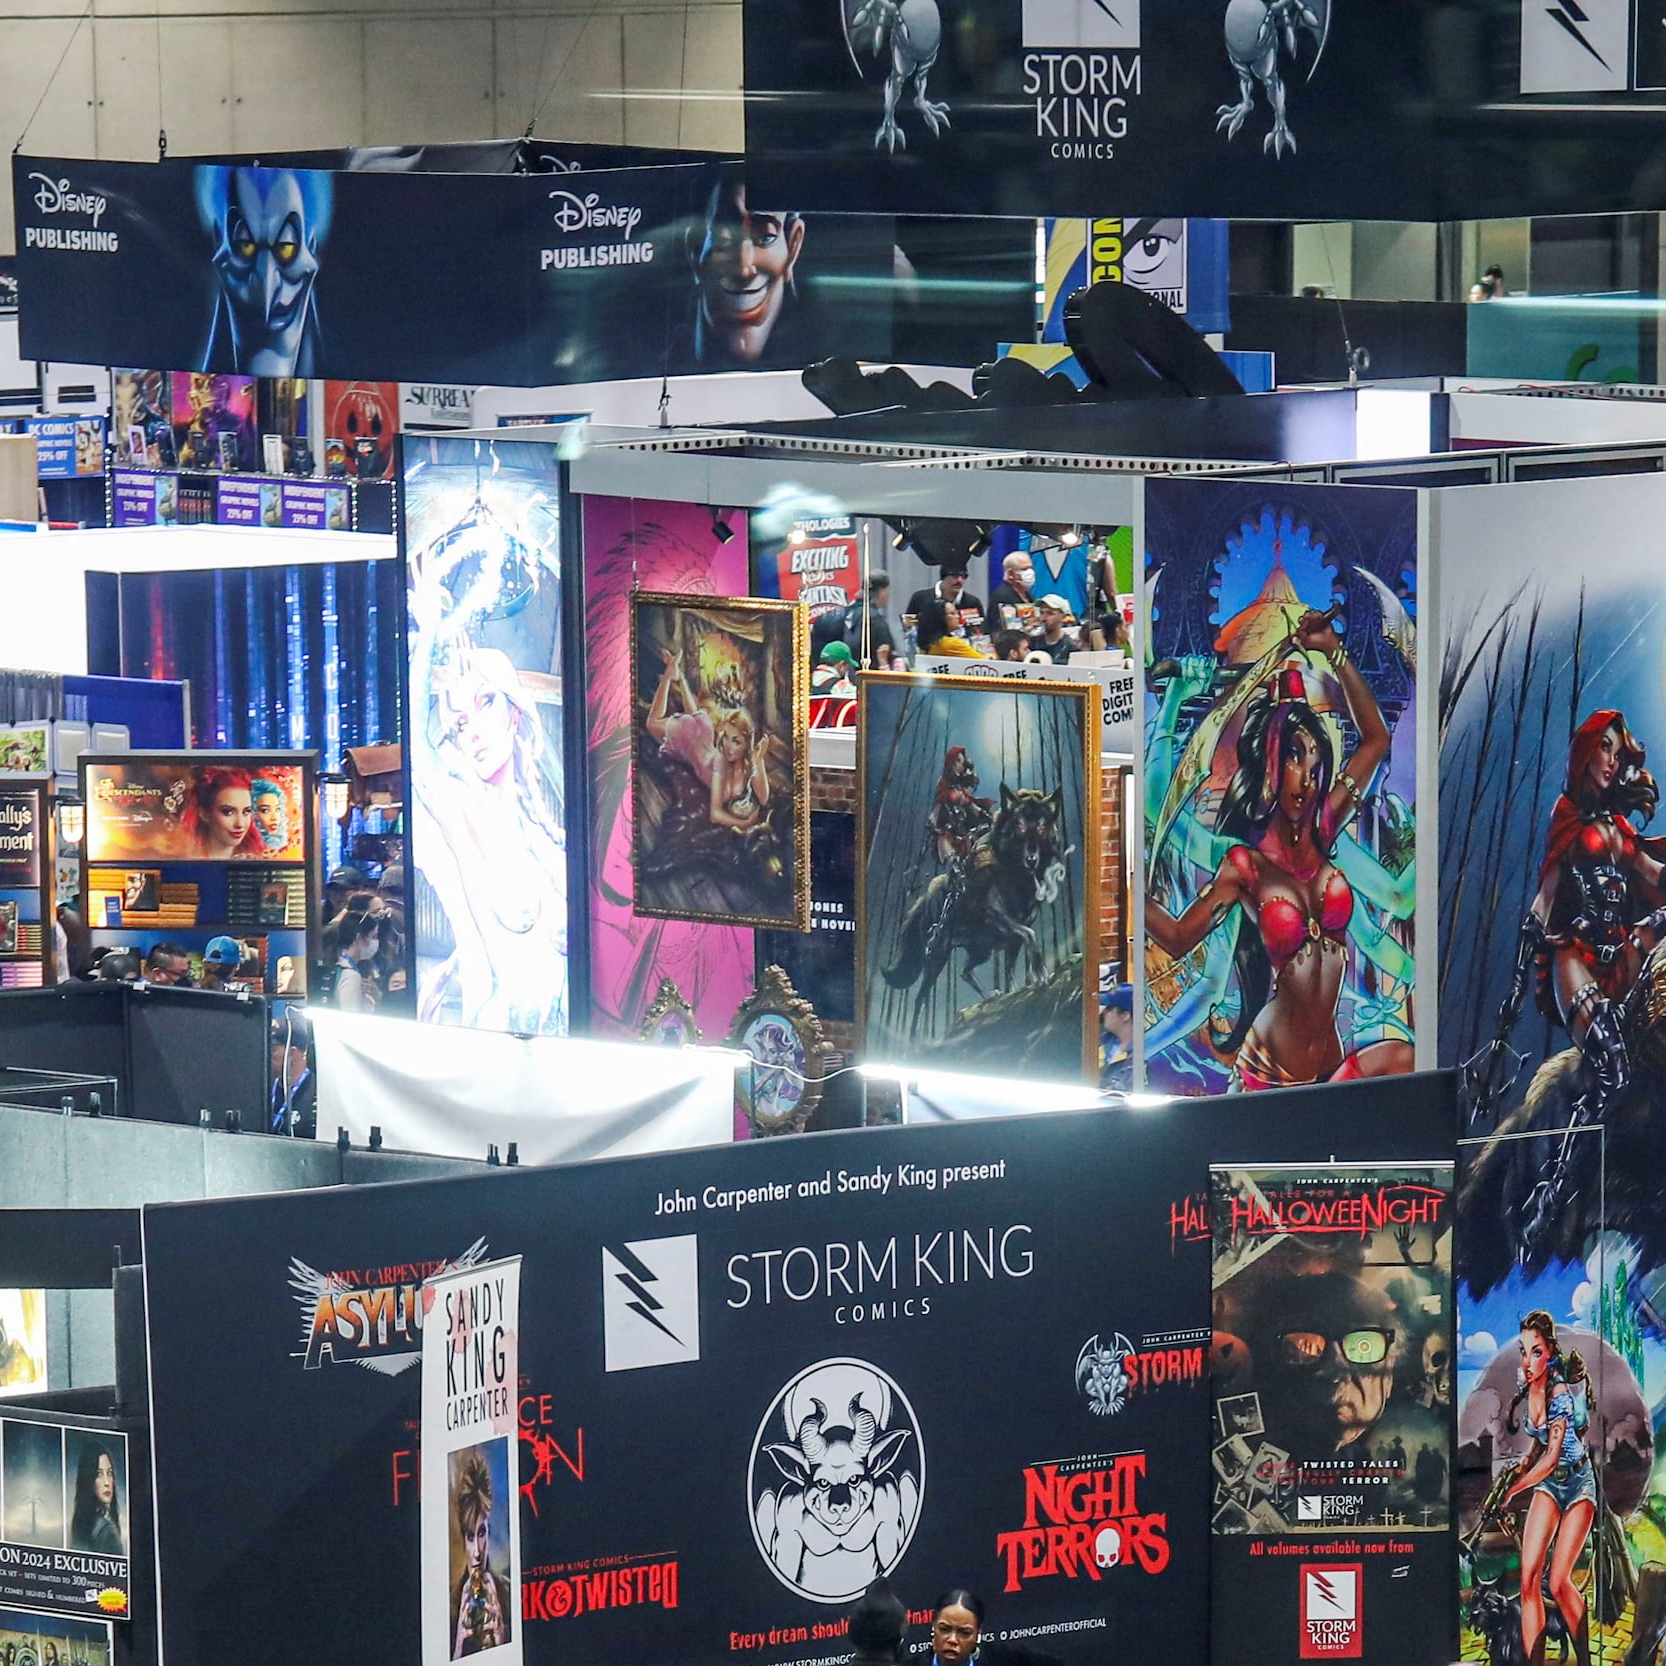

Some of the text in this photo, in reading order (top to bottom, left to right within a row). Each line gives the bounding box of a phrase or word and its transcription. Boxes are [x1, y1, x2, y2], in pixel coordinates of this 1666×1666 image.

[1023, 54, 1141, 96] STORM
[1035, 97, 1129, 138] KING
[1051, 143, 1115, 160] COMICS
[25, 228, 118, 252] PUBLISHING
[541, 242, 654, 271] PUBLISHING
[655, 1159, 1006, 1217] John Carpenter and Sandy King present
[727, 1224, 1034, 1309] STORM KING
[446, 1278, 505, 1337] SANDY
[835, 1297, 931, 1324] COMICS
[446, 1327, 506, 1397] KING
[1124, 1348, 1202, 1399] STORM
[446, 1388, 509, 1432] CARPENTER
[1024, 1455, 1145, 1532] NIGHT
[23, 1552, 51, 1570] 2024
[54, 1554, 127, 1578] EXCLUSIVE
[1250, 1540, 1414, 1555] All volumes available now from
[730, 1626, 807, 1651] Every dream
